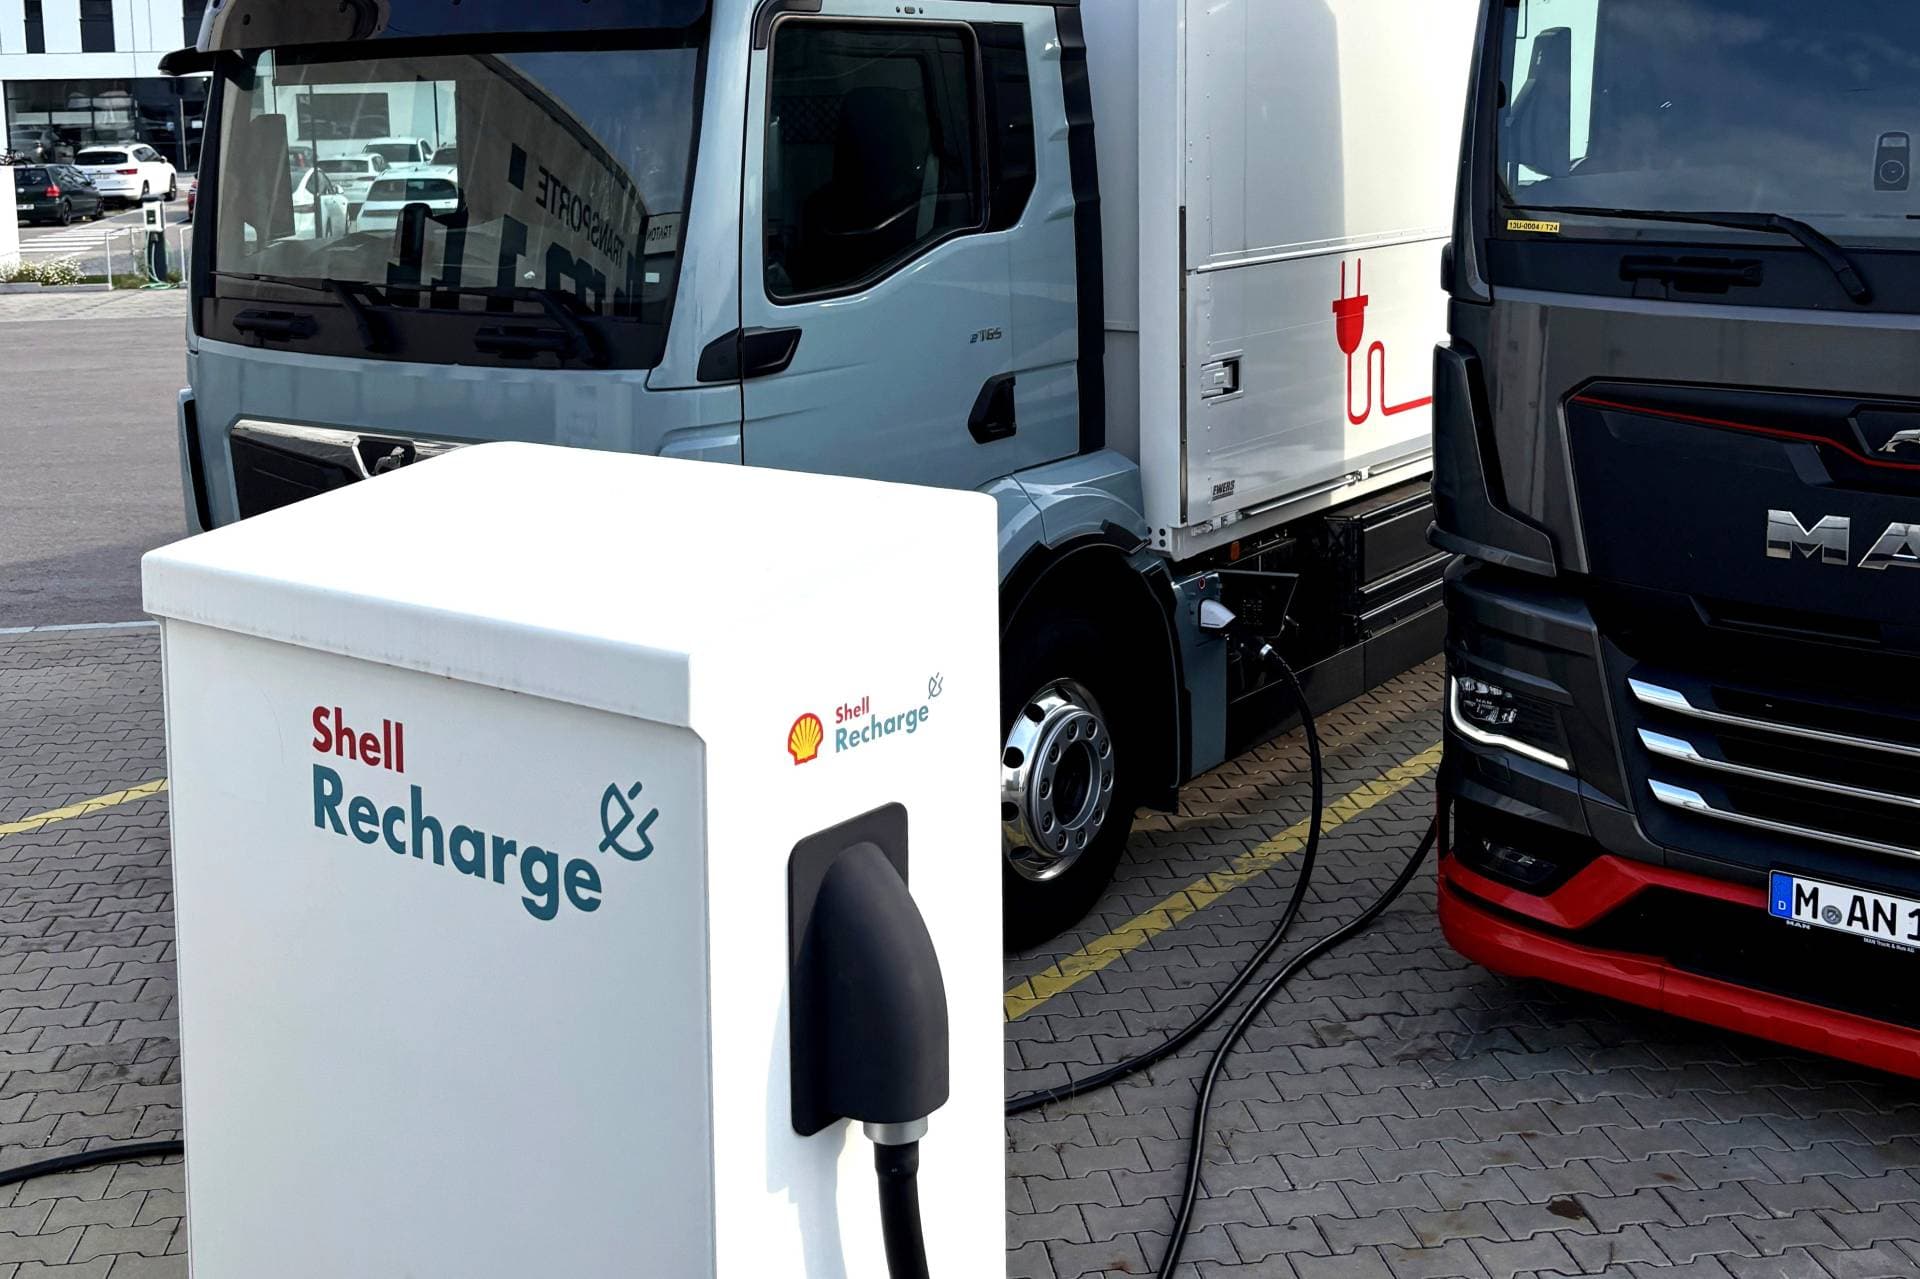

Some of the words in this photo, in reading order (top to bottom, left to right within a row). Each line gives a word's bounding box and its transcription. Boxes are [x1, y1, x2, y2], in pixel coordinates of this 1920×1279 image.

[835, 696, 869, 724] Shell
[835, 704, 929, 753] Recharge
[312, 706, 404, 774] Shell
[313, 764, 602, 921] Recharge
[1778, 901, 1786, 910] D
